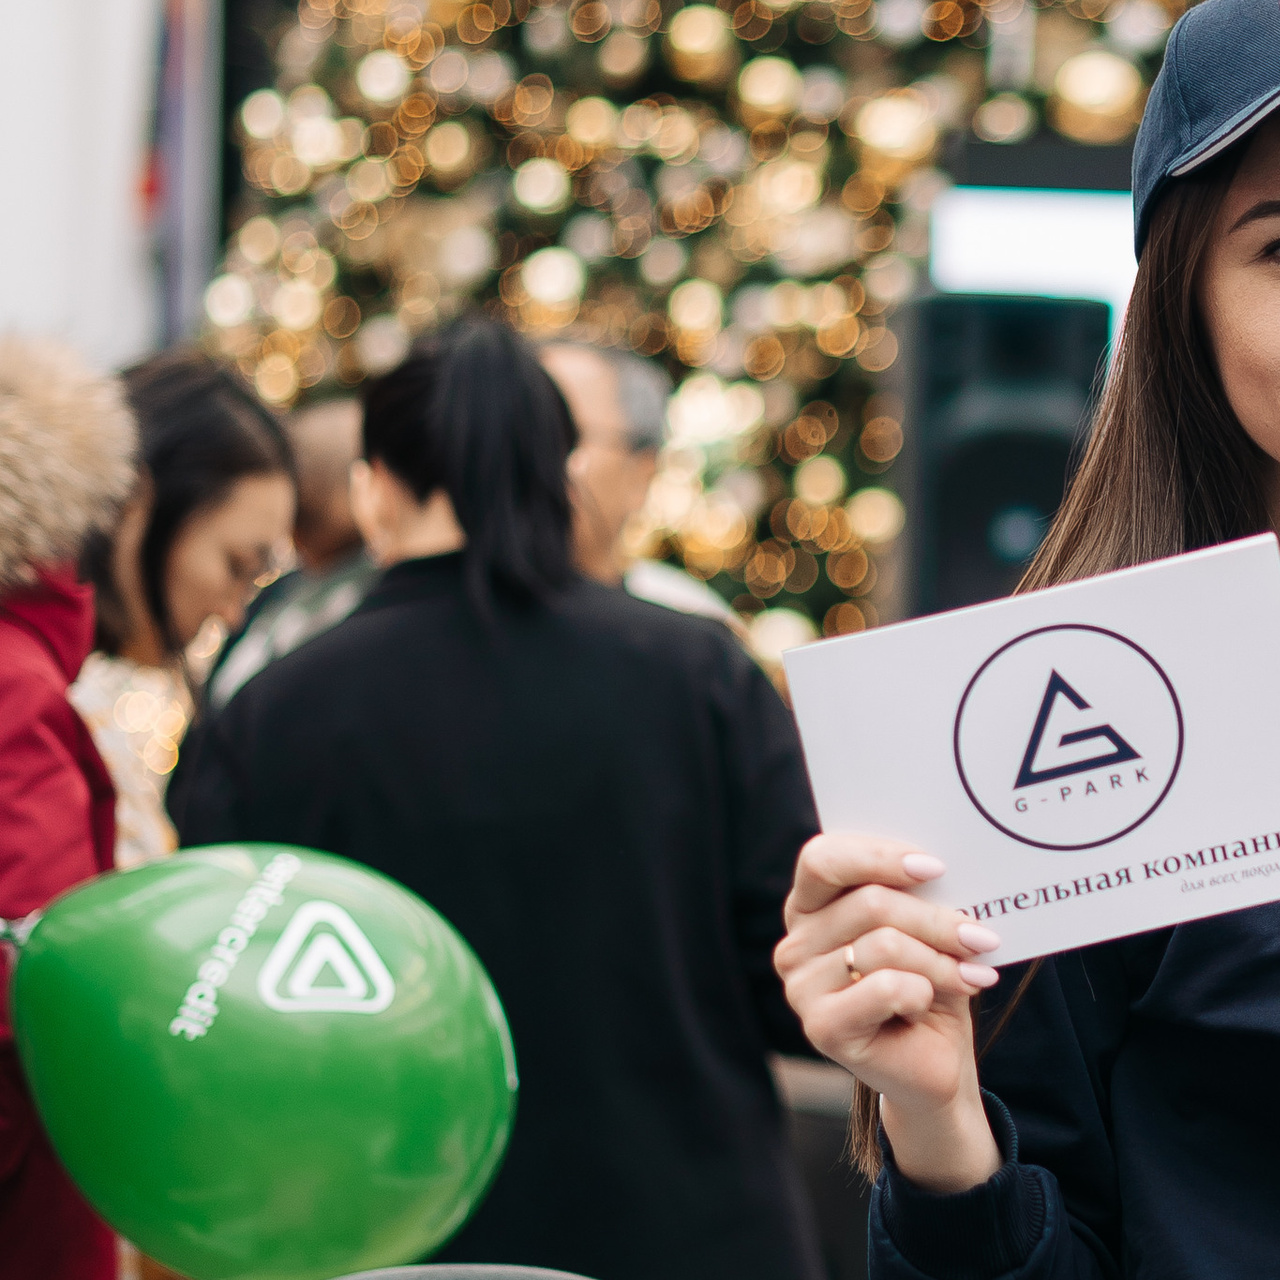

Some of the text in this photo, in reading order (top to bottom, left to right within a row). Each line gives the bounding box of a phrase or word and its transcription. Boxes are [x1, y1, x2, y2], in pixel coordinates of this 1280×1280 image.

[1014, 766, 1150, 813] G-PARK
[955, 866, 1135, 922] ительная
[1180, 878, 1205, 894] для
[1209, 871, 1239, 886] всех
